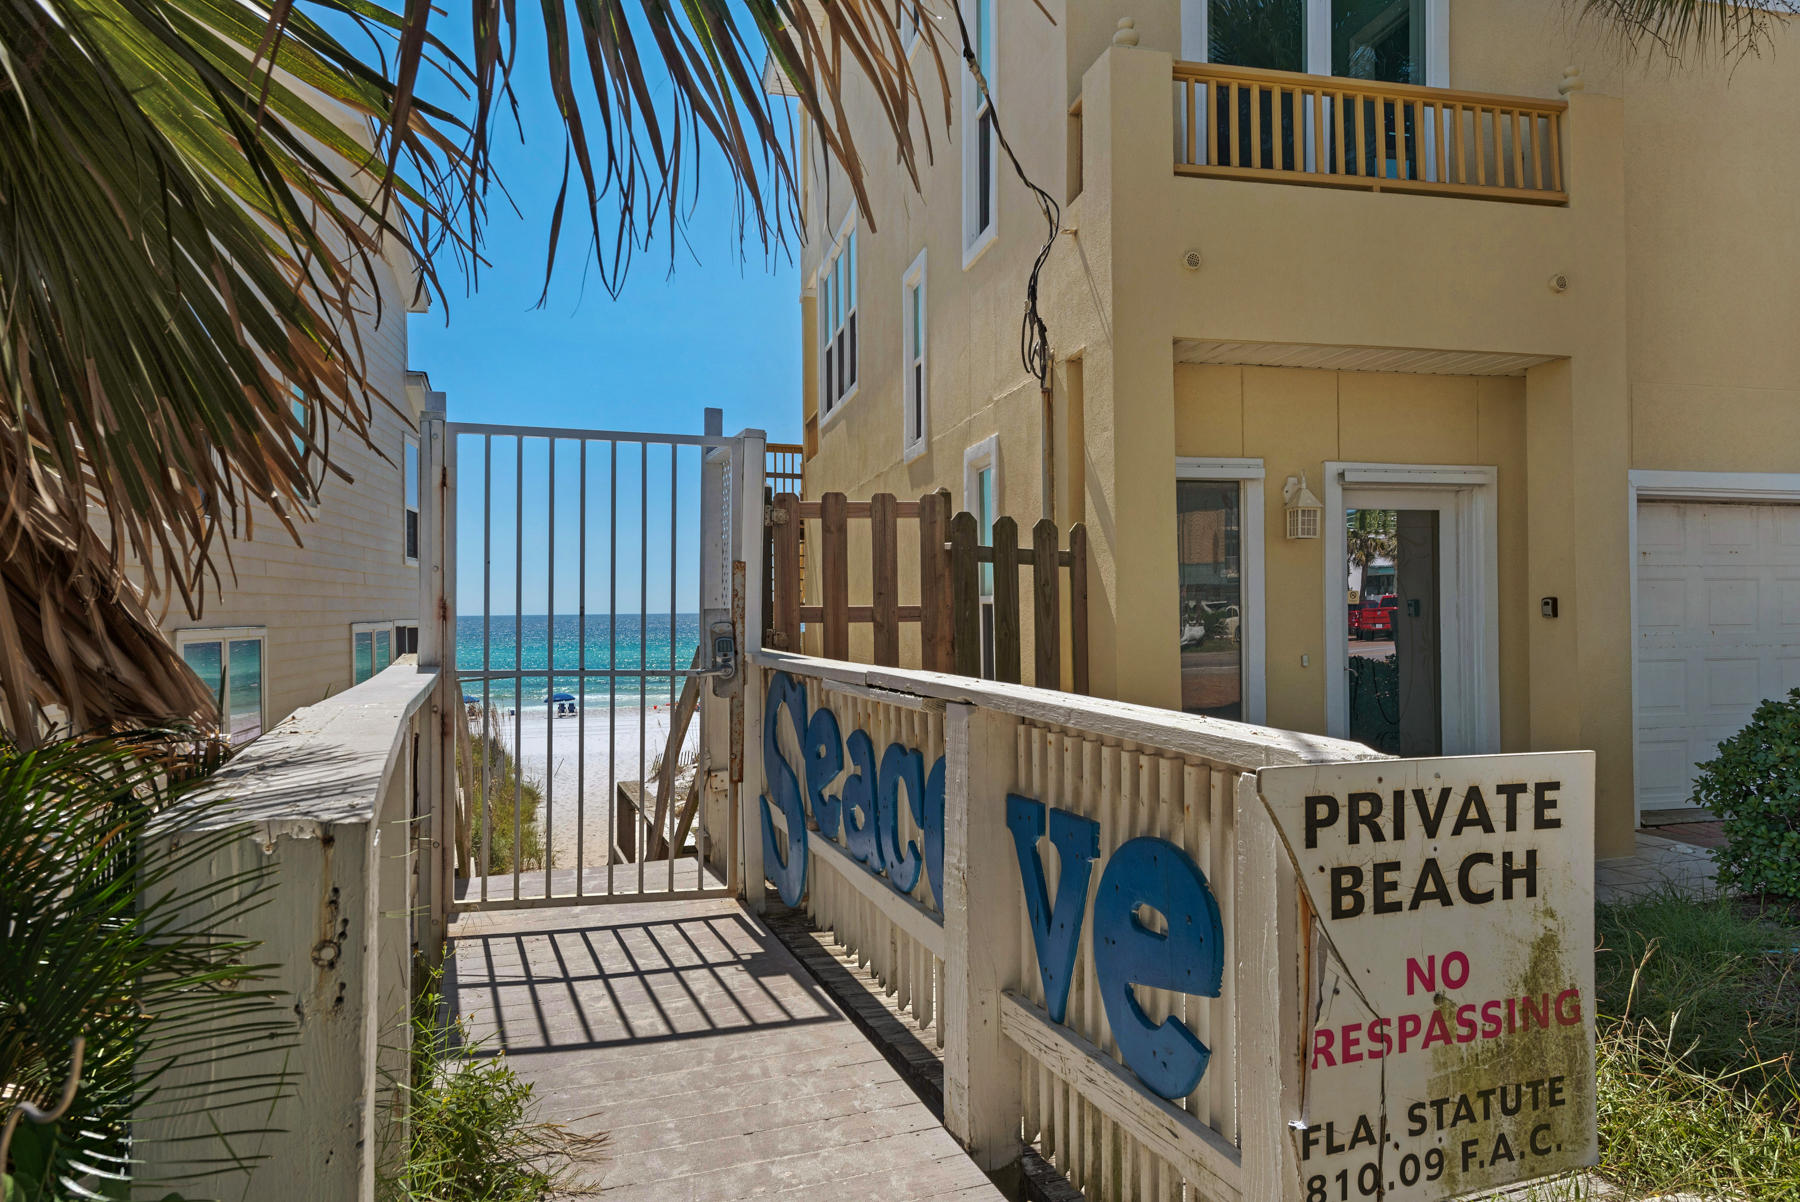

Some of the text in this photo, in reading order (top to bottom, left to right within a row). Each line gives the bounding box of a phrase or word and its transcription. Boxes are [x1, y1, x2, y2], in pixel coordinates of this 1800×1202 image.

[1304, 781, 1562, 850] PRIVATE
[1330, 849, 1539, 921] BEACH
[1406, 951, 1471, 996] NO
[1302, 1075, 1566, 1161] FLA. STATUTE
[1306, 1123, 1562, 1202] 810.09 F.A.C.
